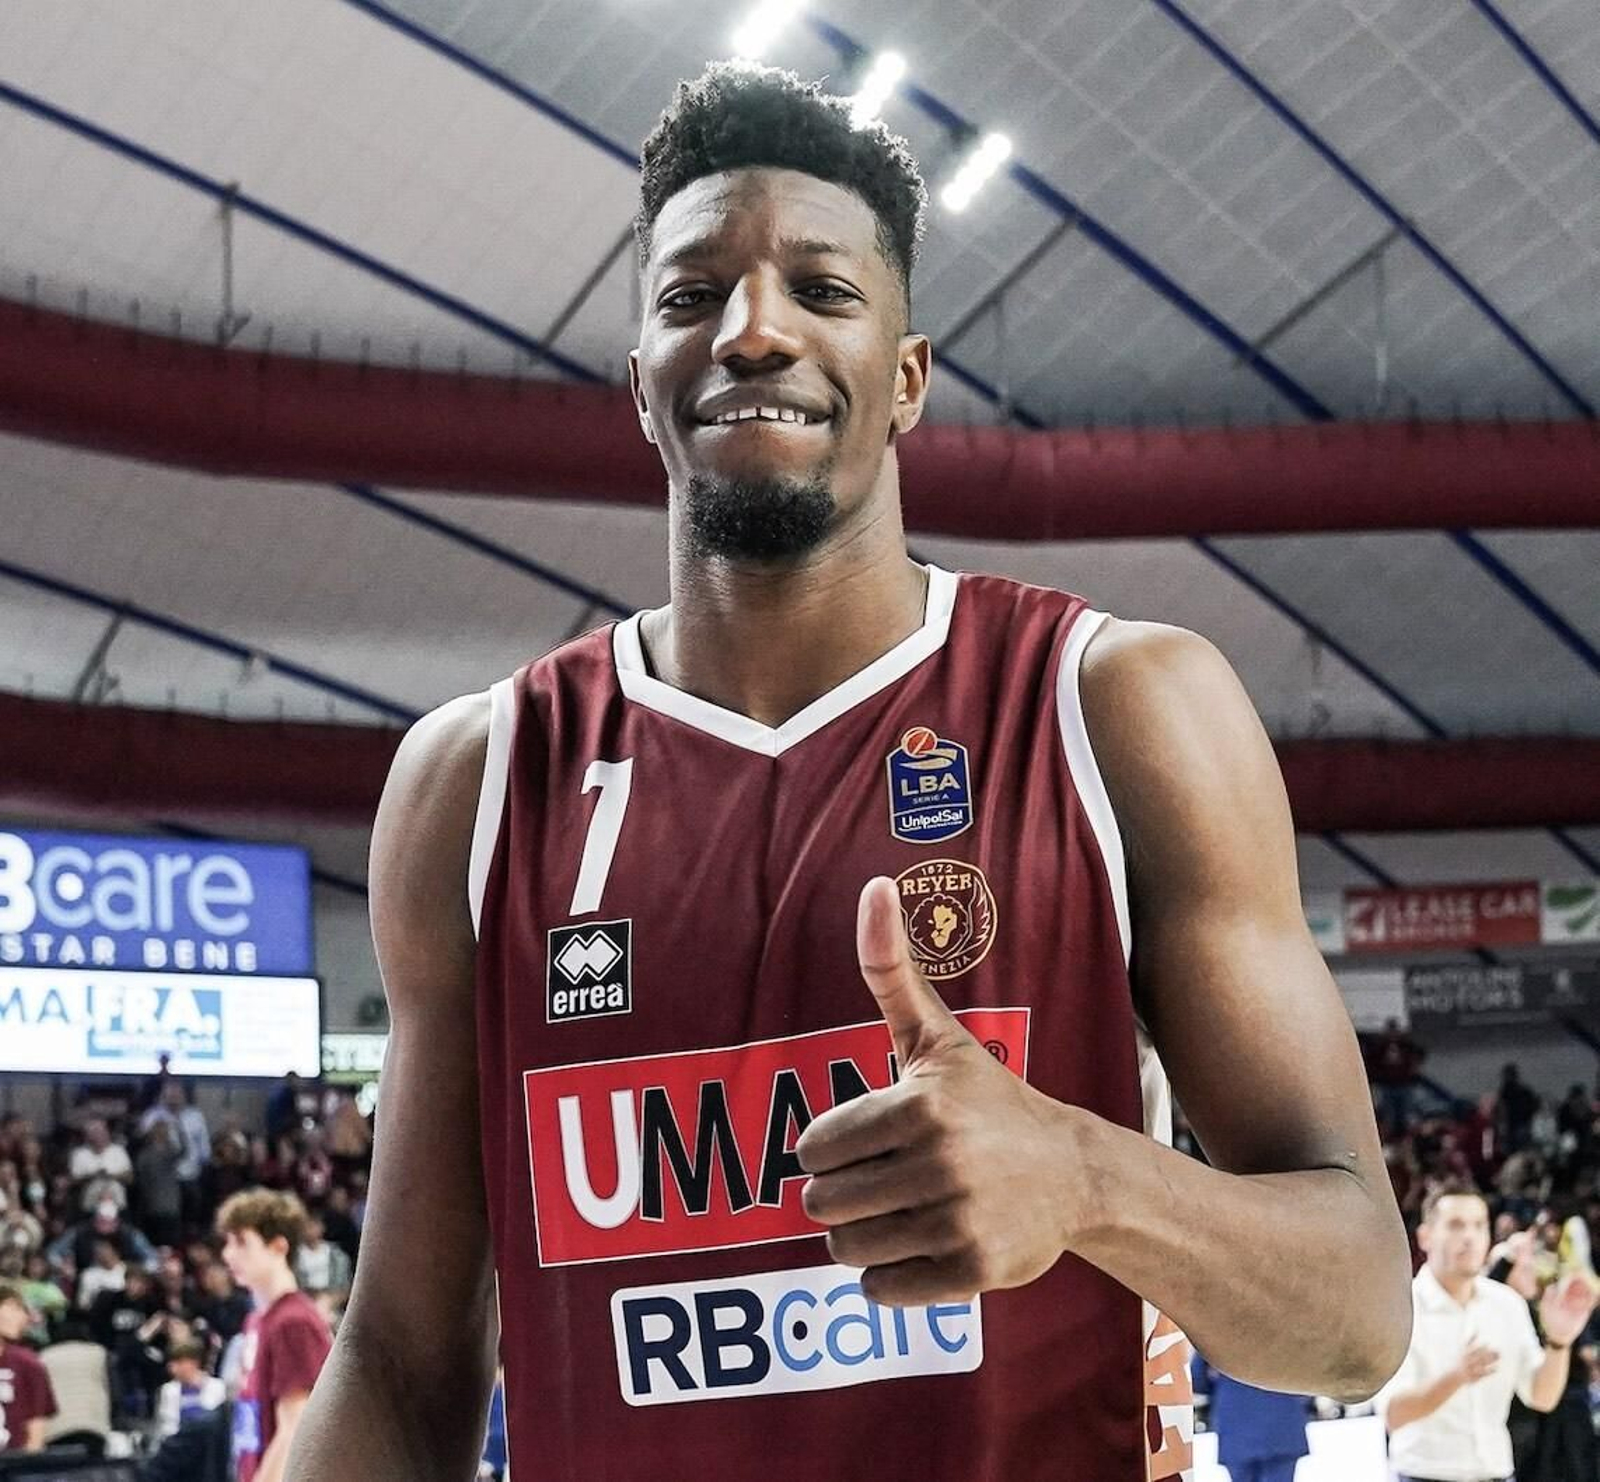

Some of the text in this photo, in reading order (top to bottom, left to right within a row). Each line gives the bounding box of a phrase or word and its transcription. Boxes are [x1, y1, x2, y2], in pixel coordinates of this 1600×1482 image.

[901, 772, 960, 797] LBA
[921, 864, 953, 876] 1872
[902, 874, 972, 896] REYER
[143, 938, 257, 972] BENE
[919, 955, 972, 974] ENEZIA
